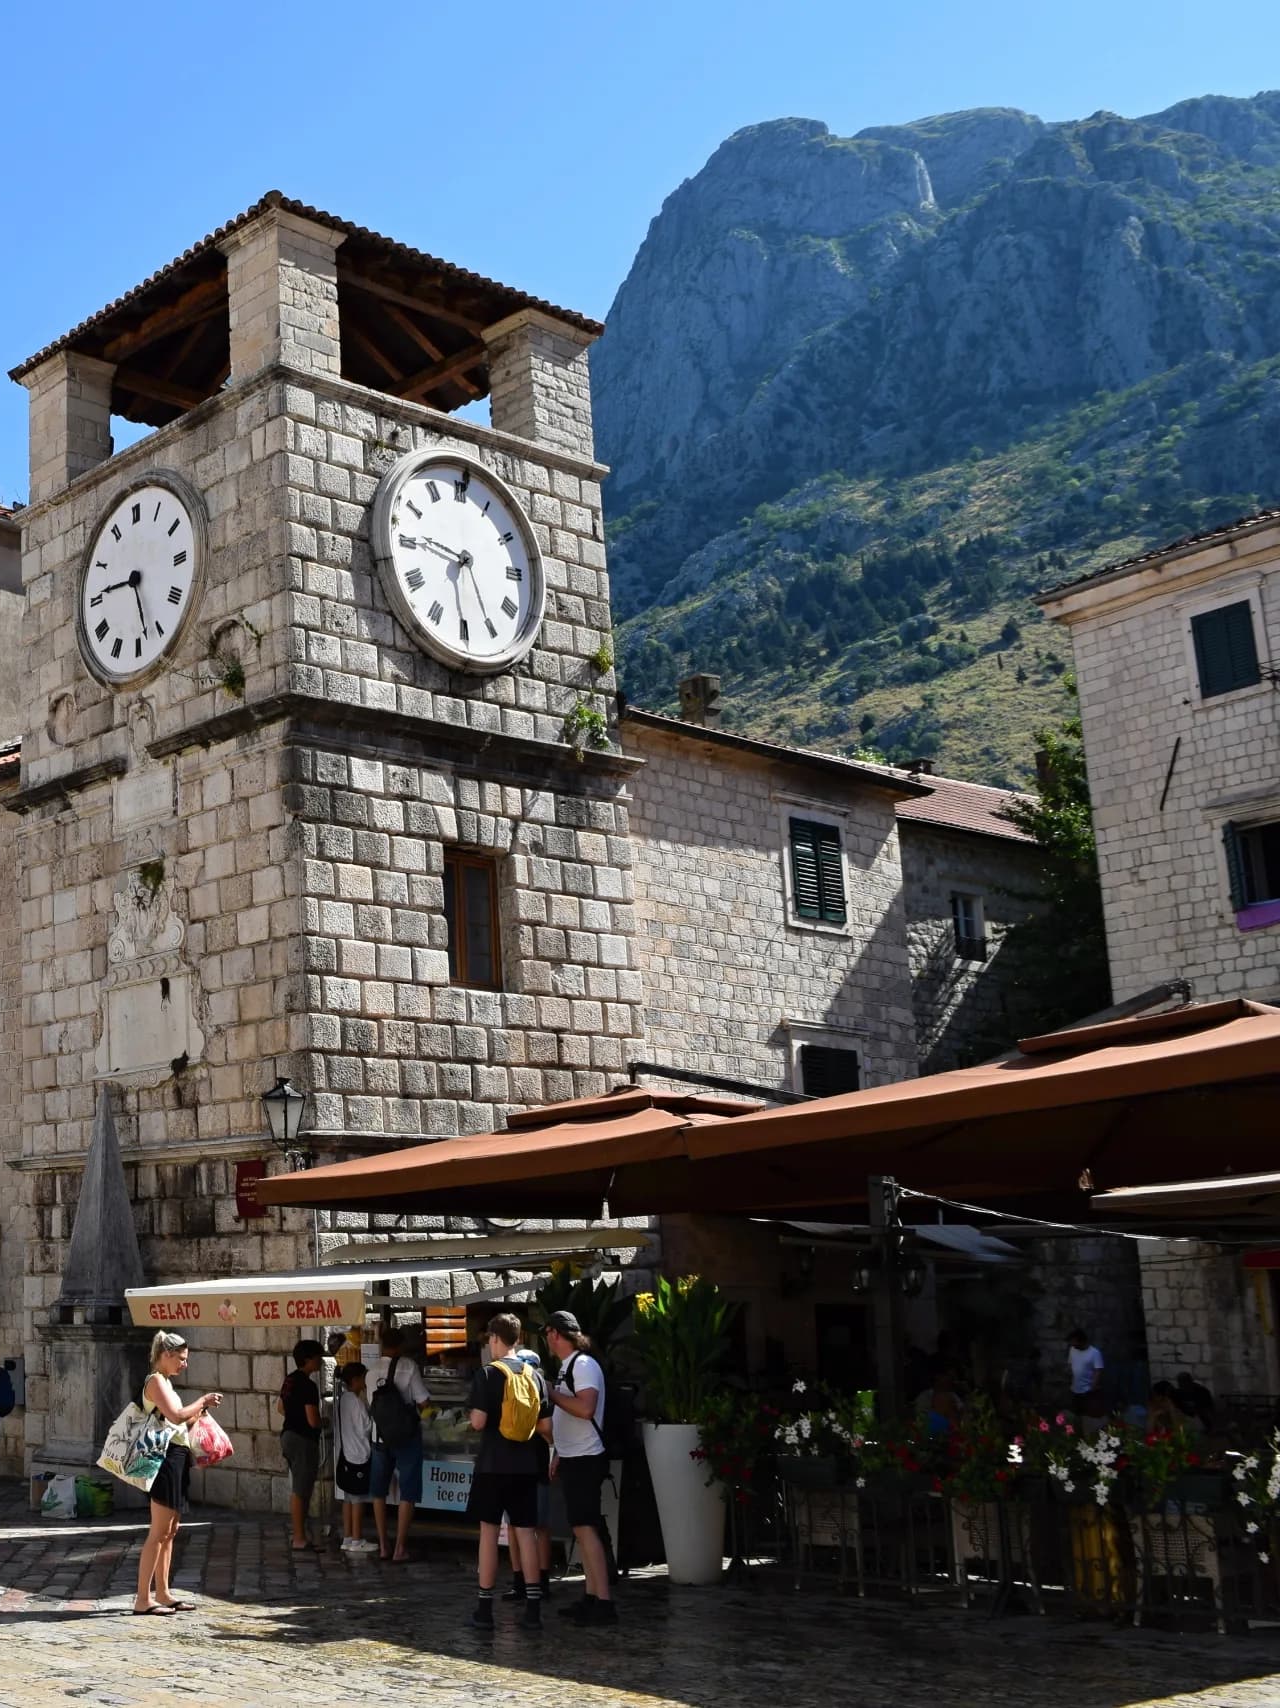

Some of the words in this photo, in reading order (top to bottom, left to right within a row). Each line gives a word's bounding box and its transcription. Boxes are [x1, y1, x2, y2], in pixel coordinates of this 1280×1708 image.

[425, 480, 441, 503] XI
[154, 502, 161, 522] I
[406, 499, 423, 520] X
[481, 501, 490, 517] I
[168, 518, 180, 536] II
[497, 531, 514, 545] II
[96, 560, 108, 569] X
[173, 551, 187, 566] III
[506, 566, 522, 581] III
[155, 620, 165, 638] V
[484, 618, 498, 639] V
[149, 1302, 201, 1320] GELATO
[253, 1300, 281, 1320] ICE
[287, 1299, 342, 1319] CREAM
[431, 1466, 466, 1484] Home
[437, 1486, 454, 1502] ice
